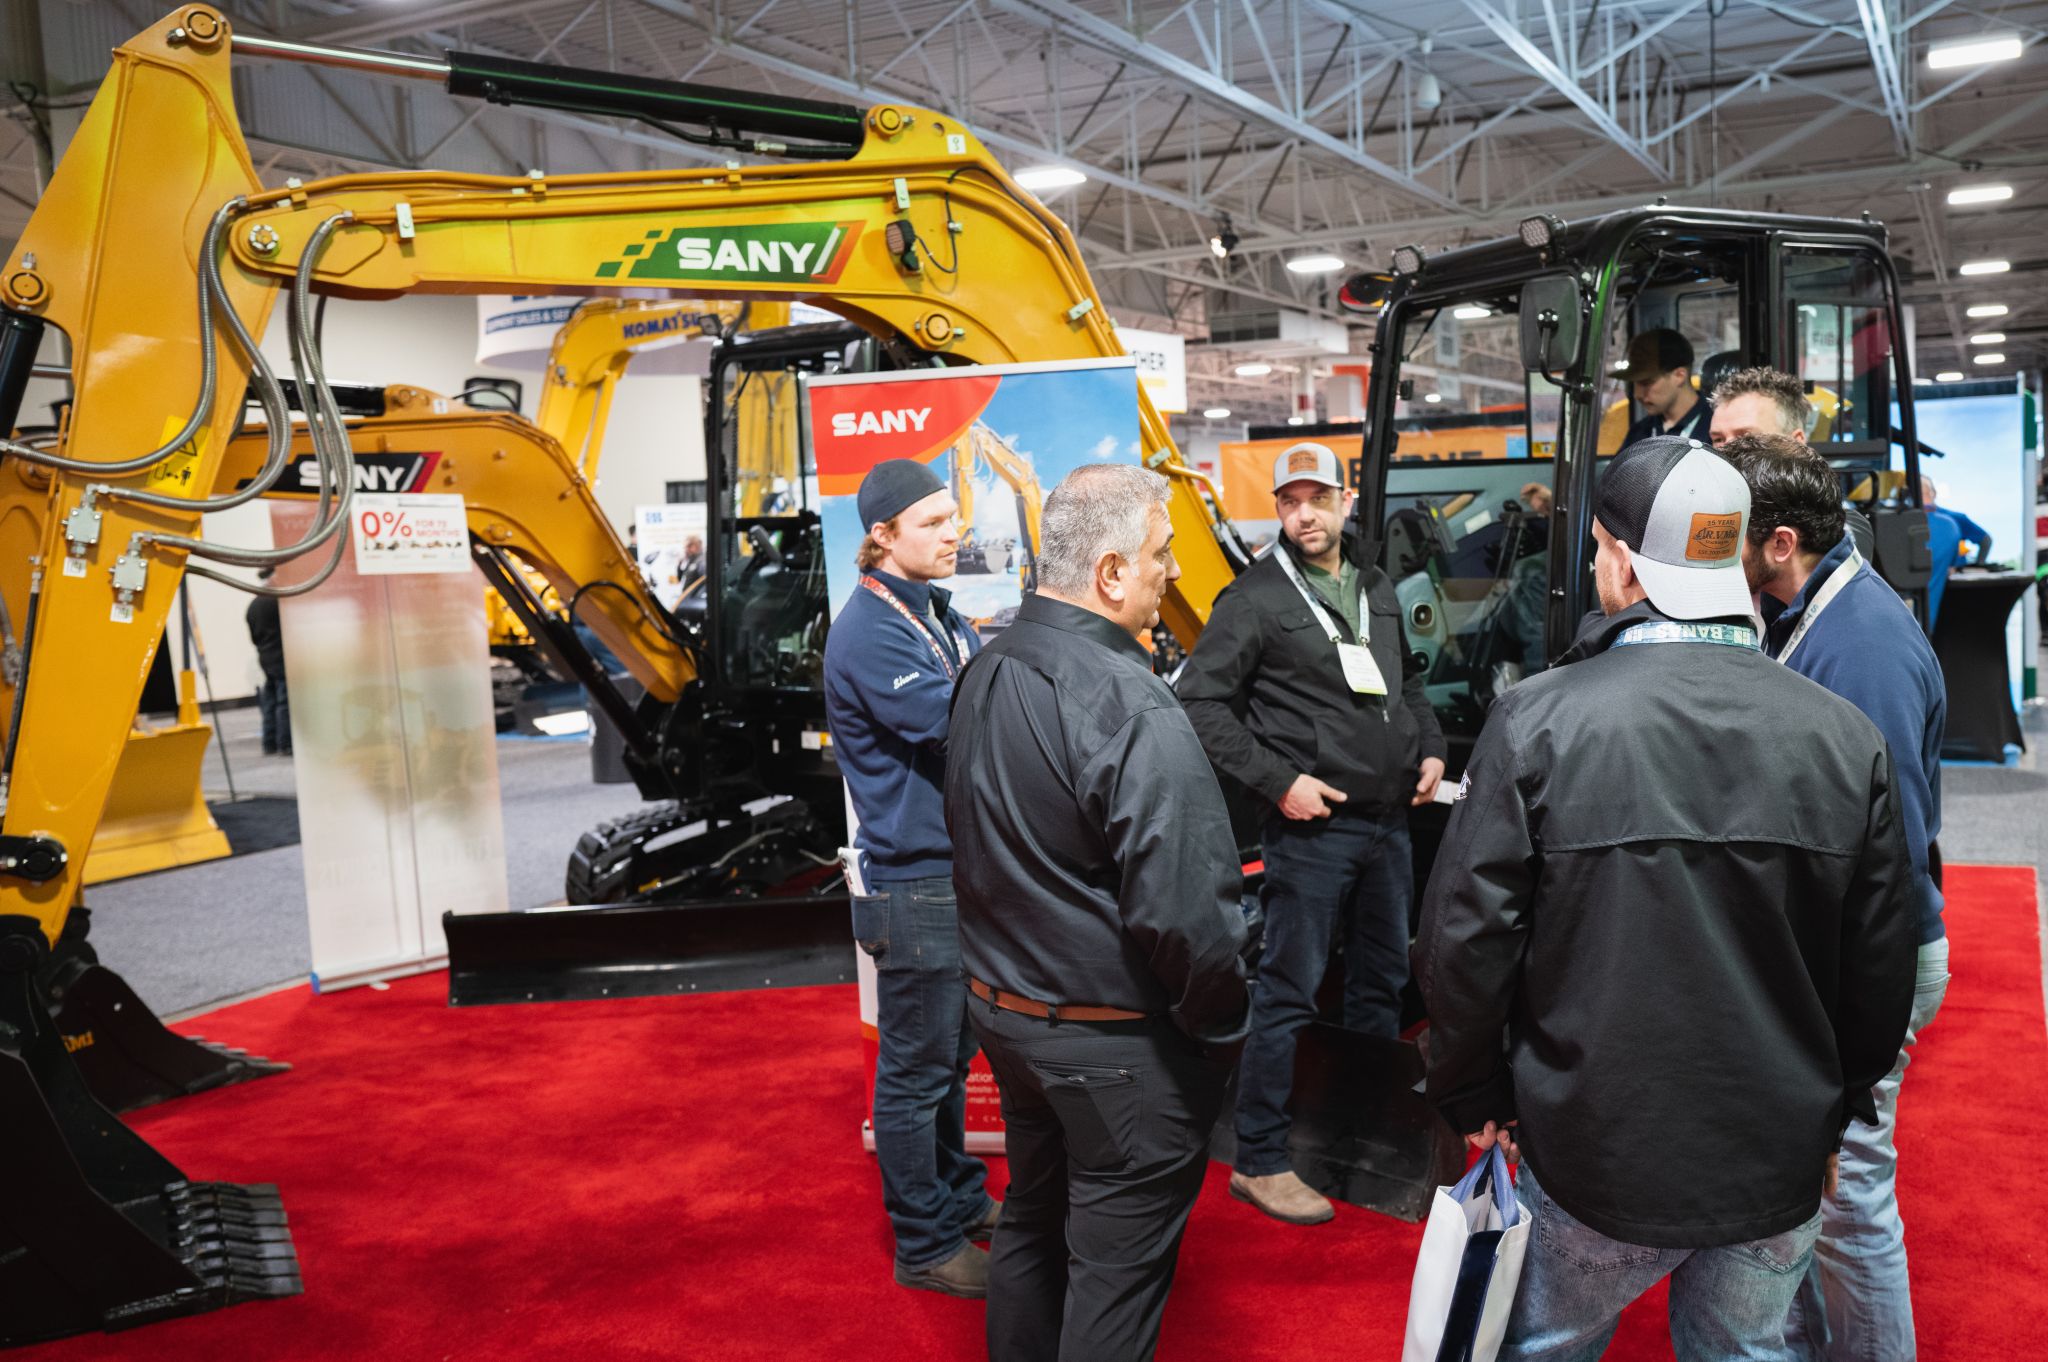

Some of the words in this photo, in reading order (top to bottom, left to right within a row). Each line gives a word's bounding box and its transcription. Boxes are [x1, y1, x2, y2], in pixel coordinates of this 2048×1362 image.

[677, 237, 816, 273] SANY
[623, 310, 701, 339] KOMATSU
[832, 407, 932, 437] SANY
[299, 460, 405, 491] SNY
[361, 511, 412, 538] 0%
